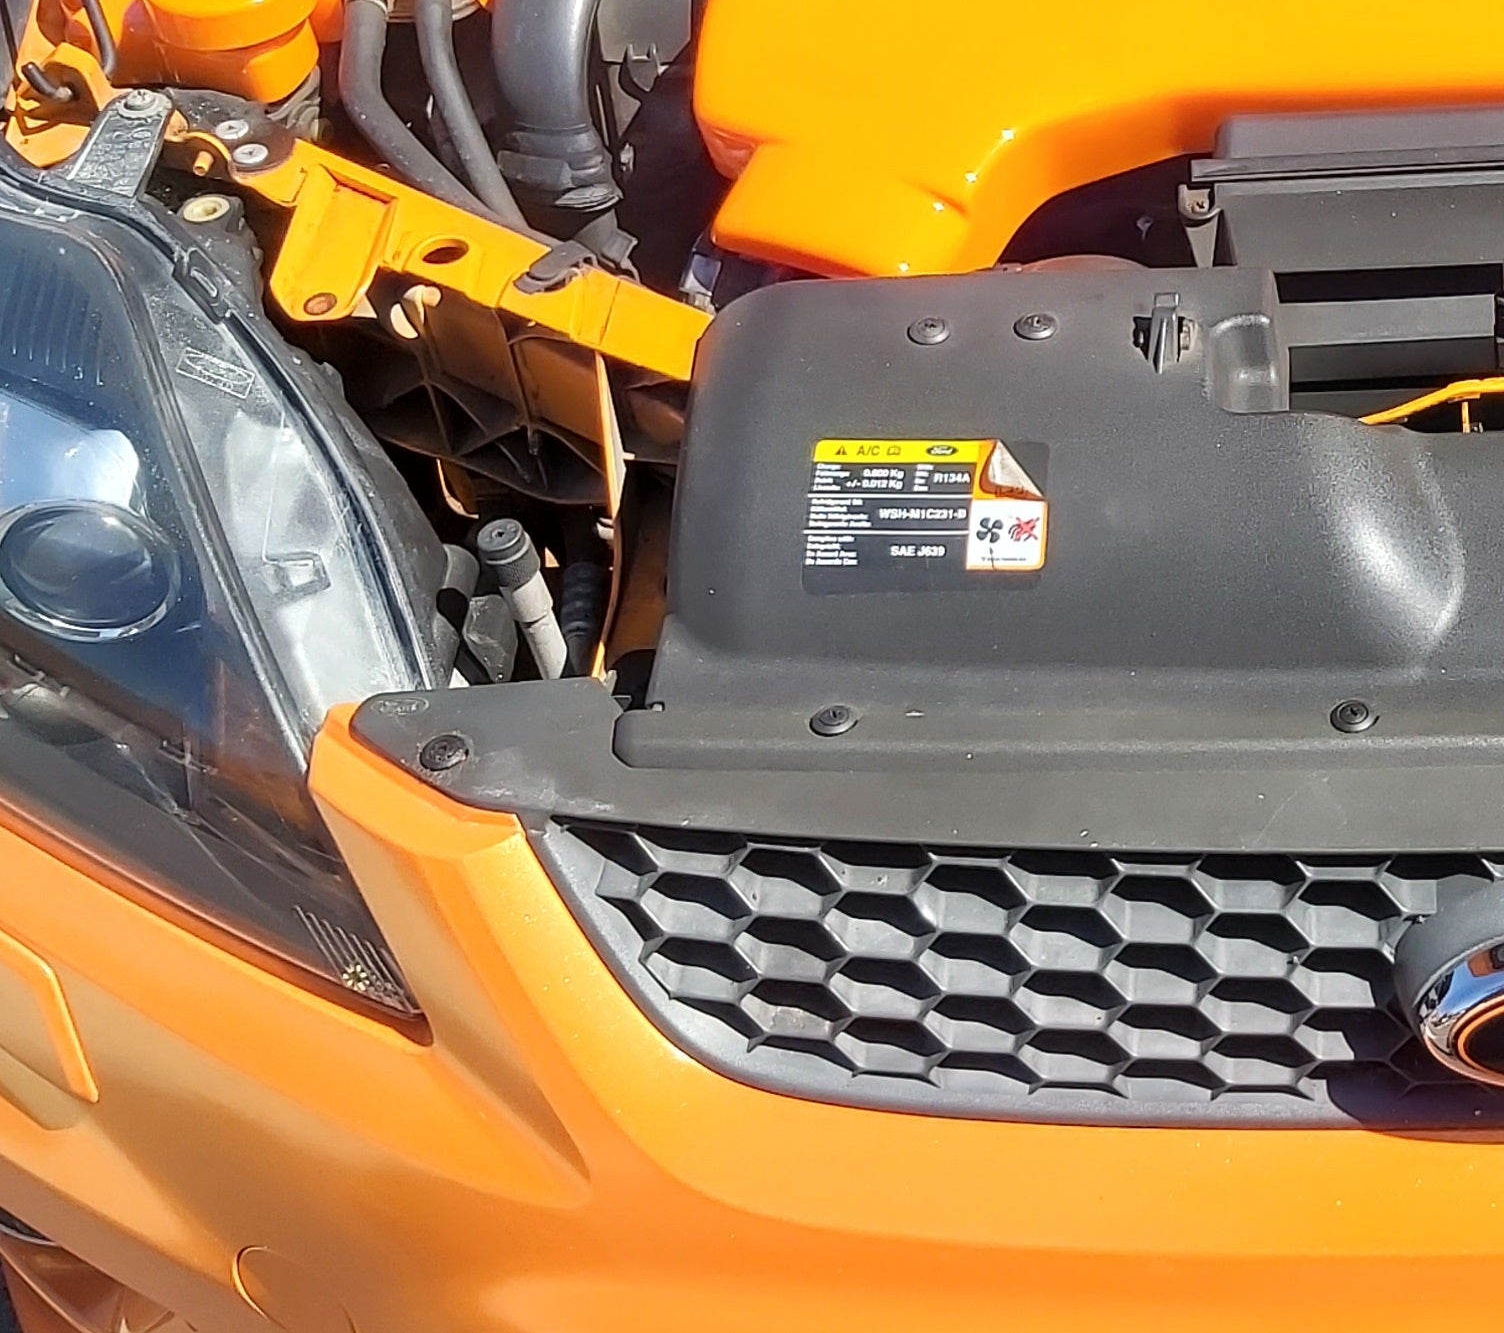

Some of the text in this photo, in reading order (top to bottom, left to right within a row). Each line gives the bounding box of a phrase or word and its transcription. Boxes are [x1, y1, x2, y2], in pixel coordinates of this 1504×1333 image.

[857, 445, 880, 456] A/C
[889, 469, 905, 480] Kg
[934, 473, 971, 484] R134A
[888, 480, 903, 491] Kg
[890, 545, 916, 557] SAE
